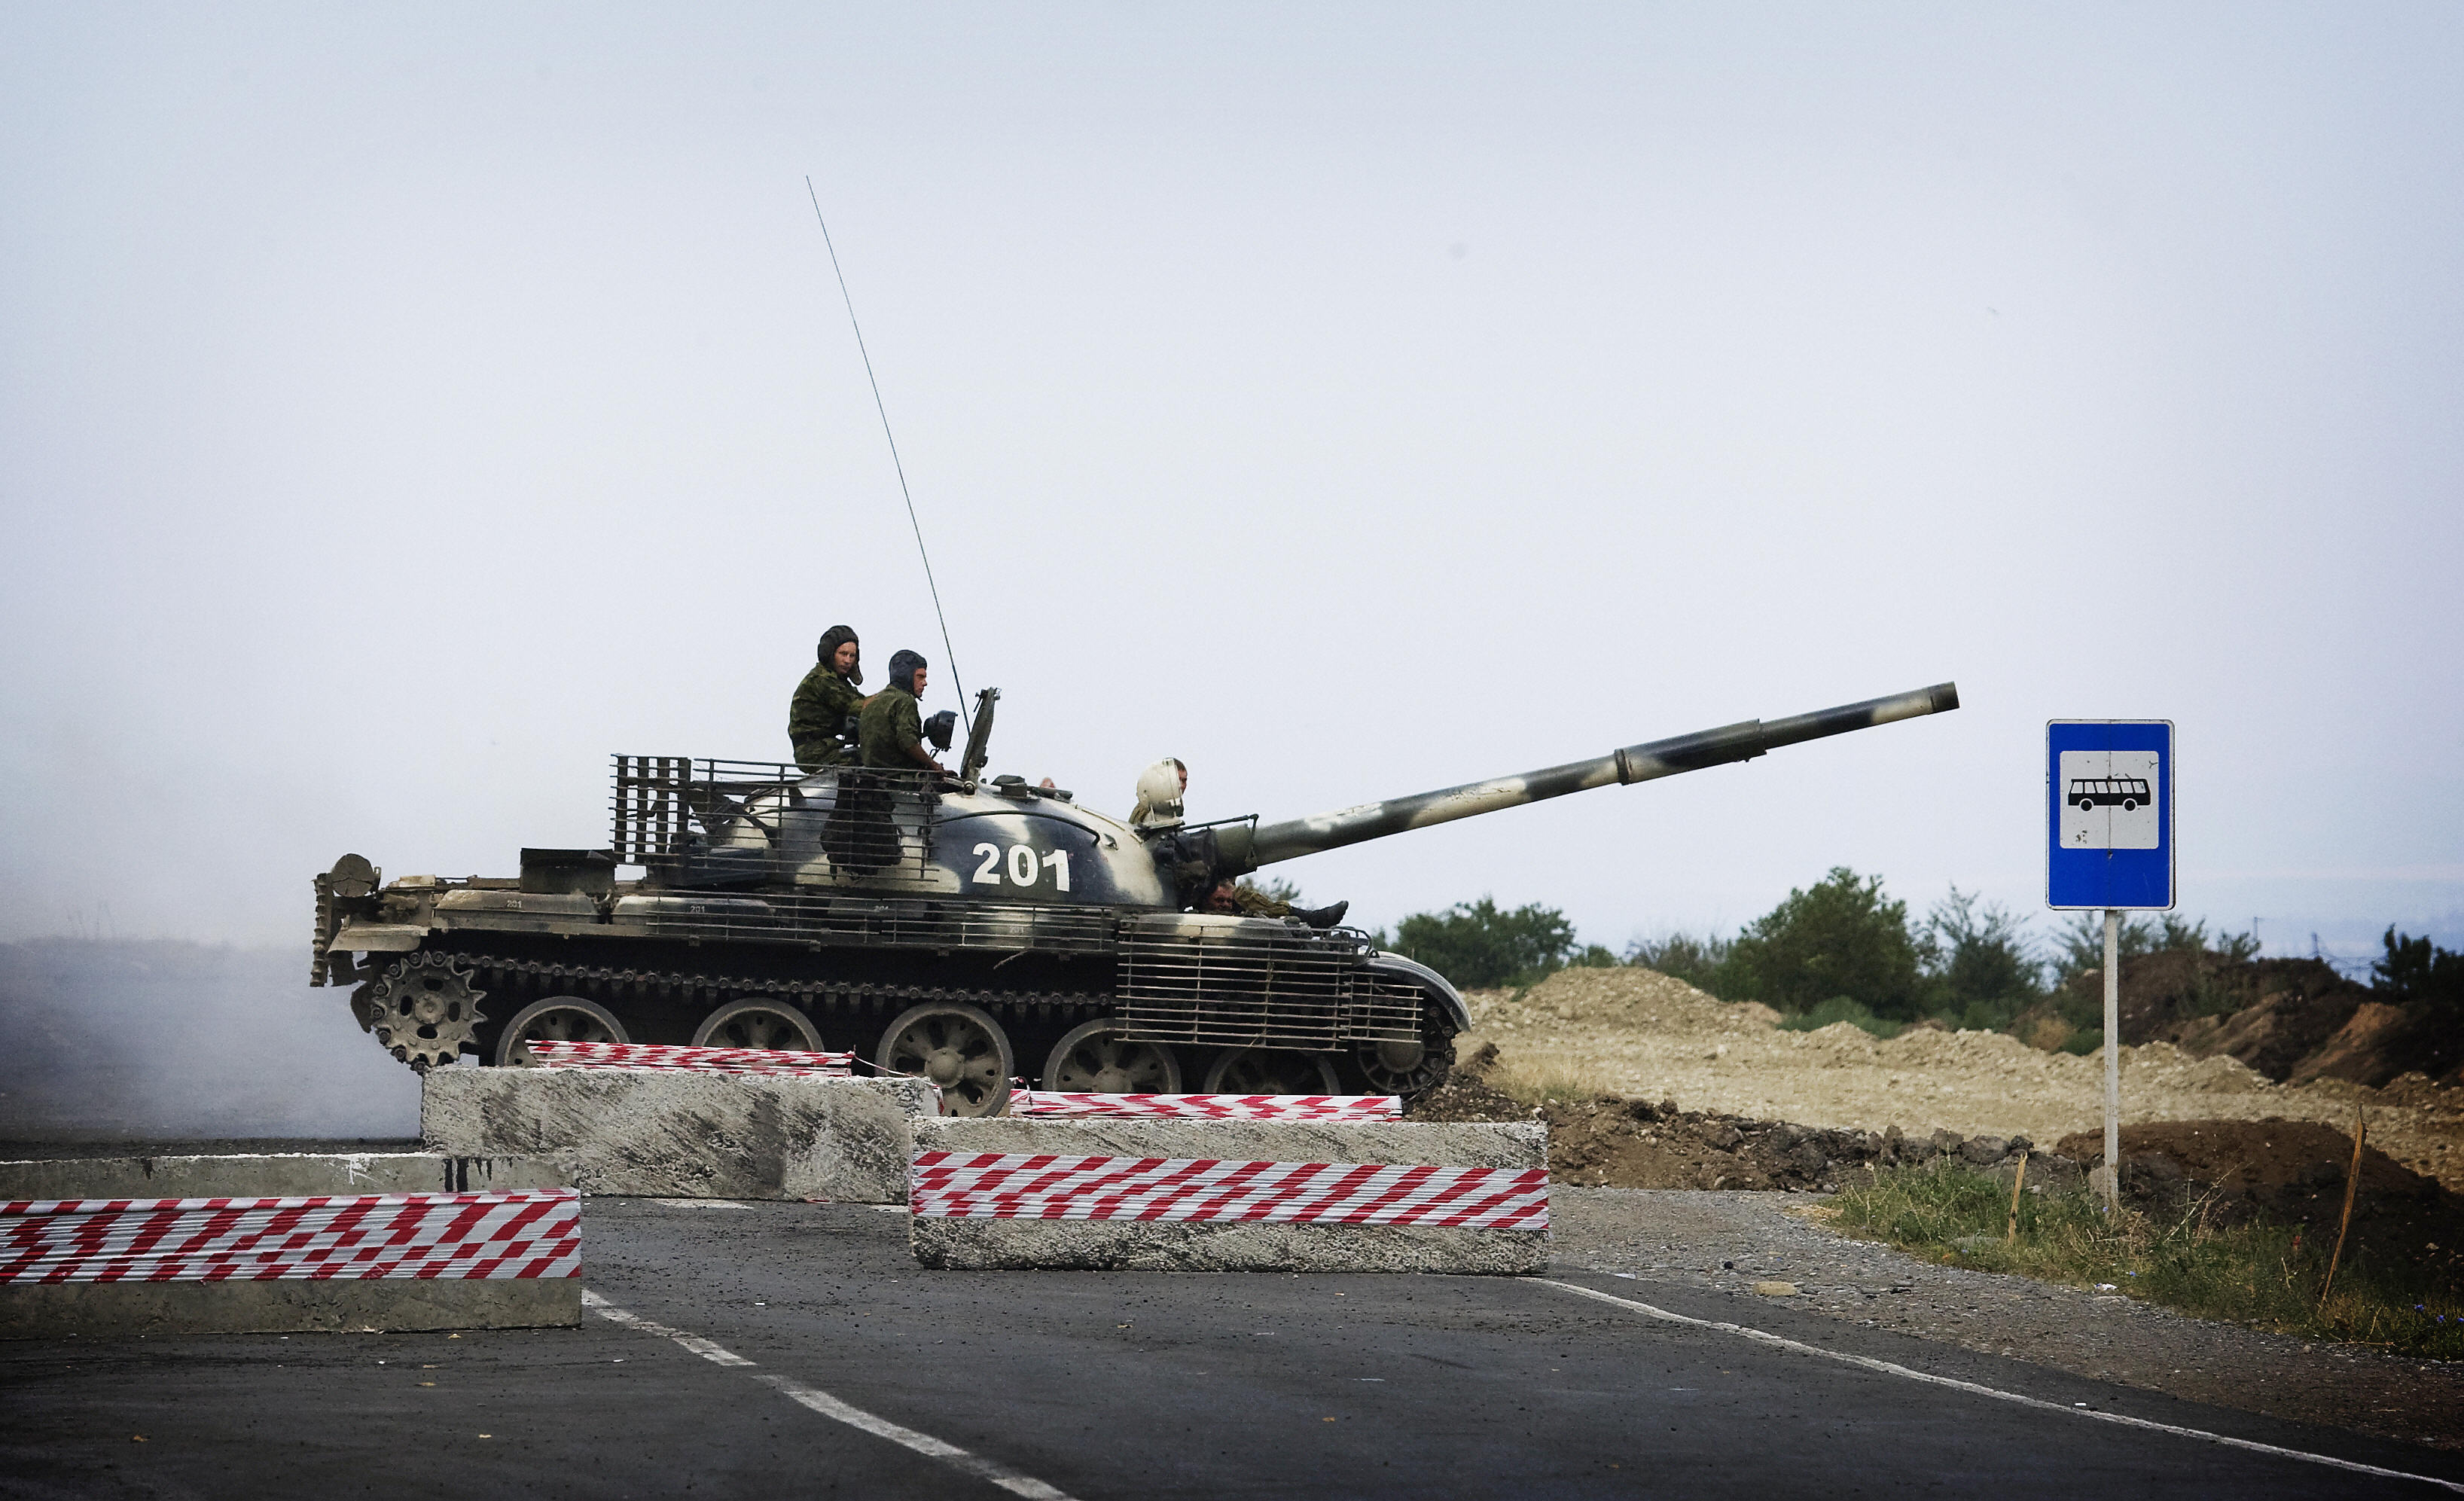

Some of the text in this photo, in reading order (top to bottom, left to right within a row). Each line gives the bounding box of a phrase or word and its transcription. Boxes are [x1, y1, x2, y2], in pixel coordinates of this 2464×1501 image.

[972, 842, 1070, 892] 201
[507, 899, 522, 908] 201
[690, 905, 705, 914] 201
